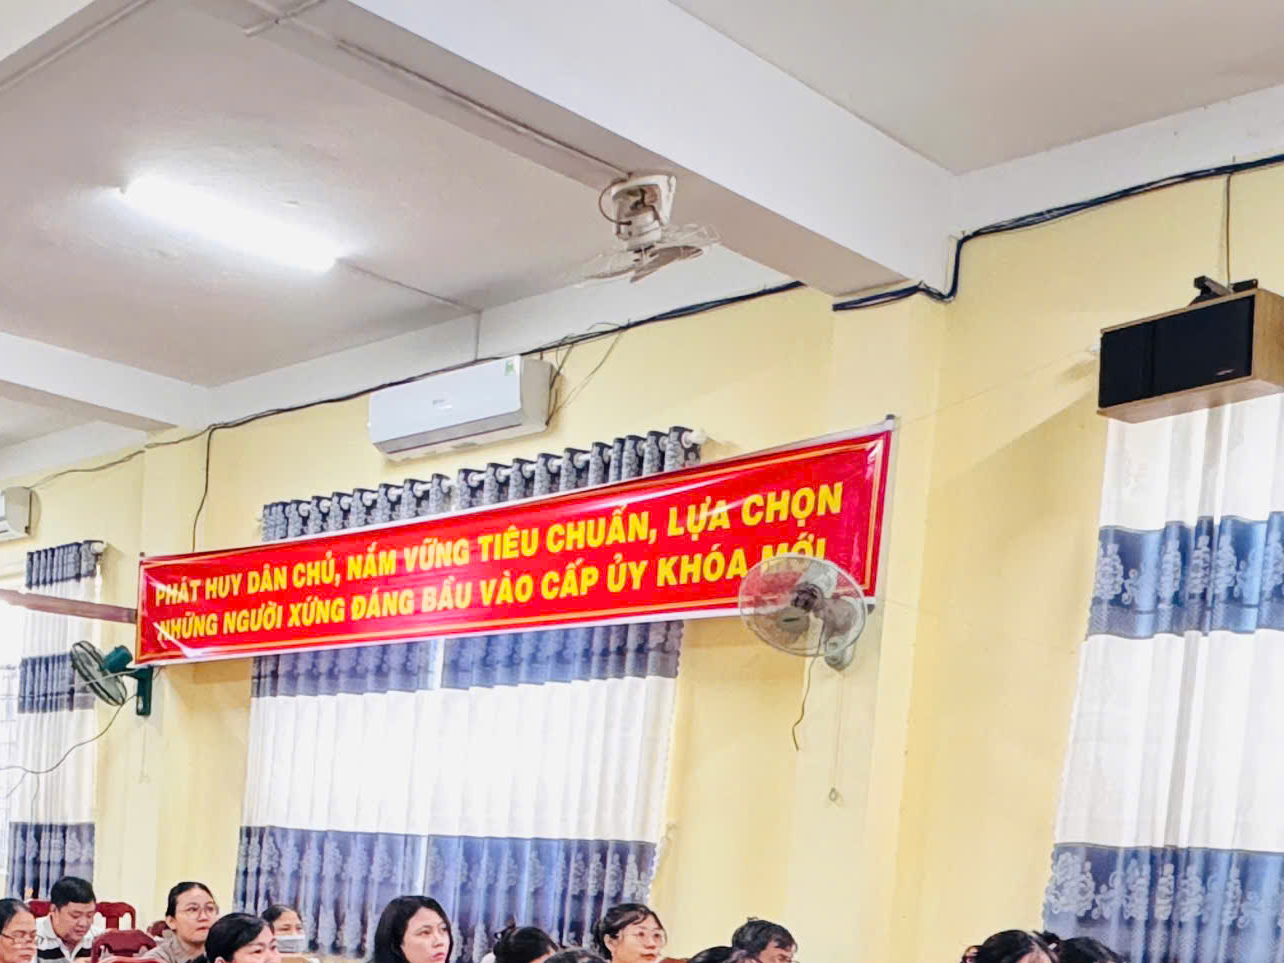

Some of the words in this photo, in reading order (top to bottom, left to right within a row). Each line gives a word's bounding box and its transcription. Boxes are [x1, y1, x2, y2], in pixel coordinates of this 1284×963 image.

[155, 575, 201, 607] PHÁT
[205, 573, 243, 600] HUY
[247, 564, 287, 595] DÂN
[292, 552, 341, 588] CHỦ,
[348, 541, 397, 581] NẮM
[404, 537, 470, 571] VỮNG
[478, 525, 539, 561] TIÊU
[546, 505, 657, 553] CHUẨN,
[667, 496, 731, 543] LỰA
[741, 482, 843, 528] CHỌN
[157, 611, 218, 641] NHỮNG
[223, 600, 282, 633] NGƯỜI
[288, 595, 345, 627] XỨNG
[351, 589, 413, 621] ĐÁNG
[421, 574, 472, 611] BẦU
[480, 570, 533, 606] VÀO
[541, 557, 599, 600] CẤP
[607, 553, 648, 592] ỦY
[657, 543, 748, 587] KHÓA
